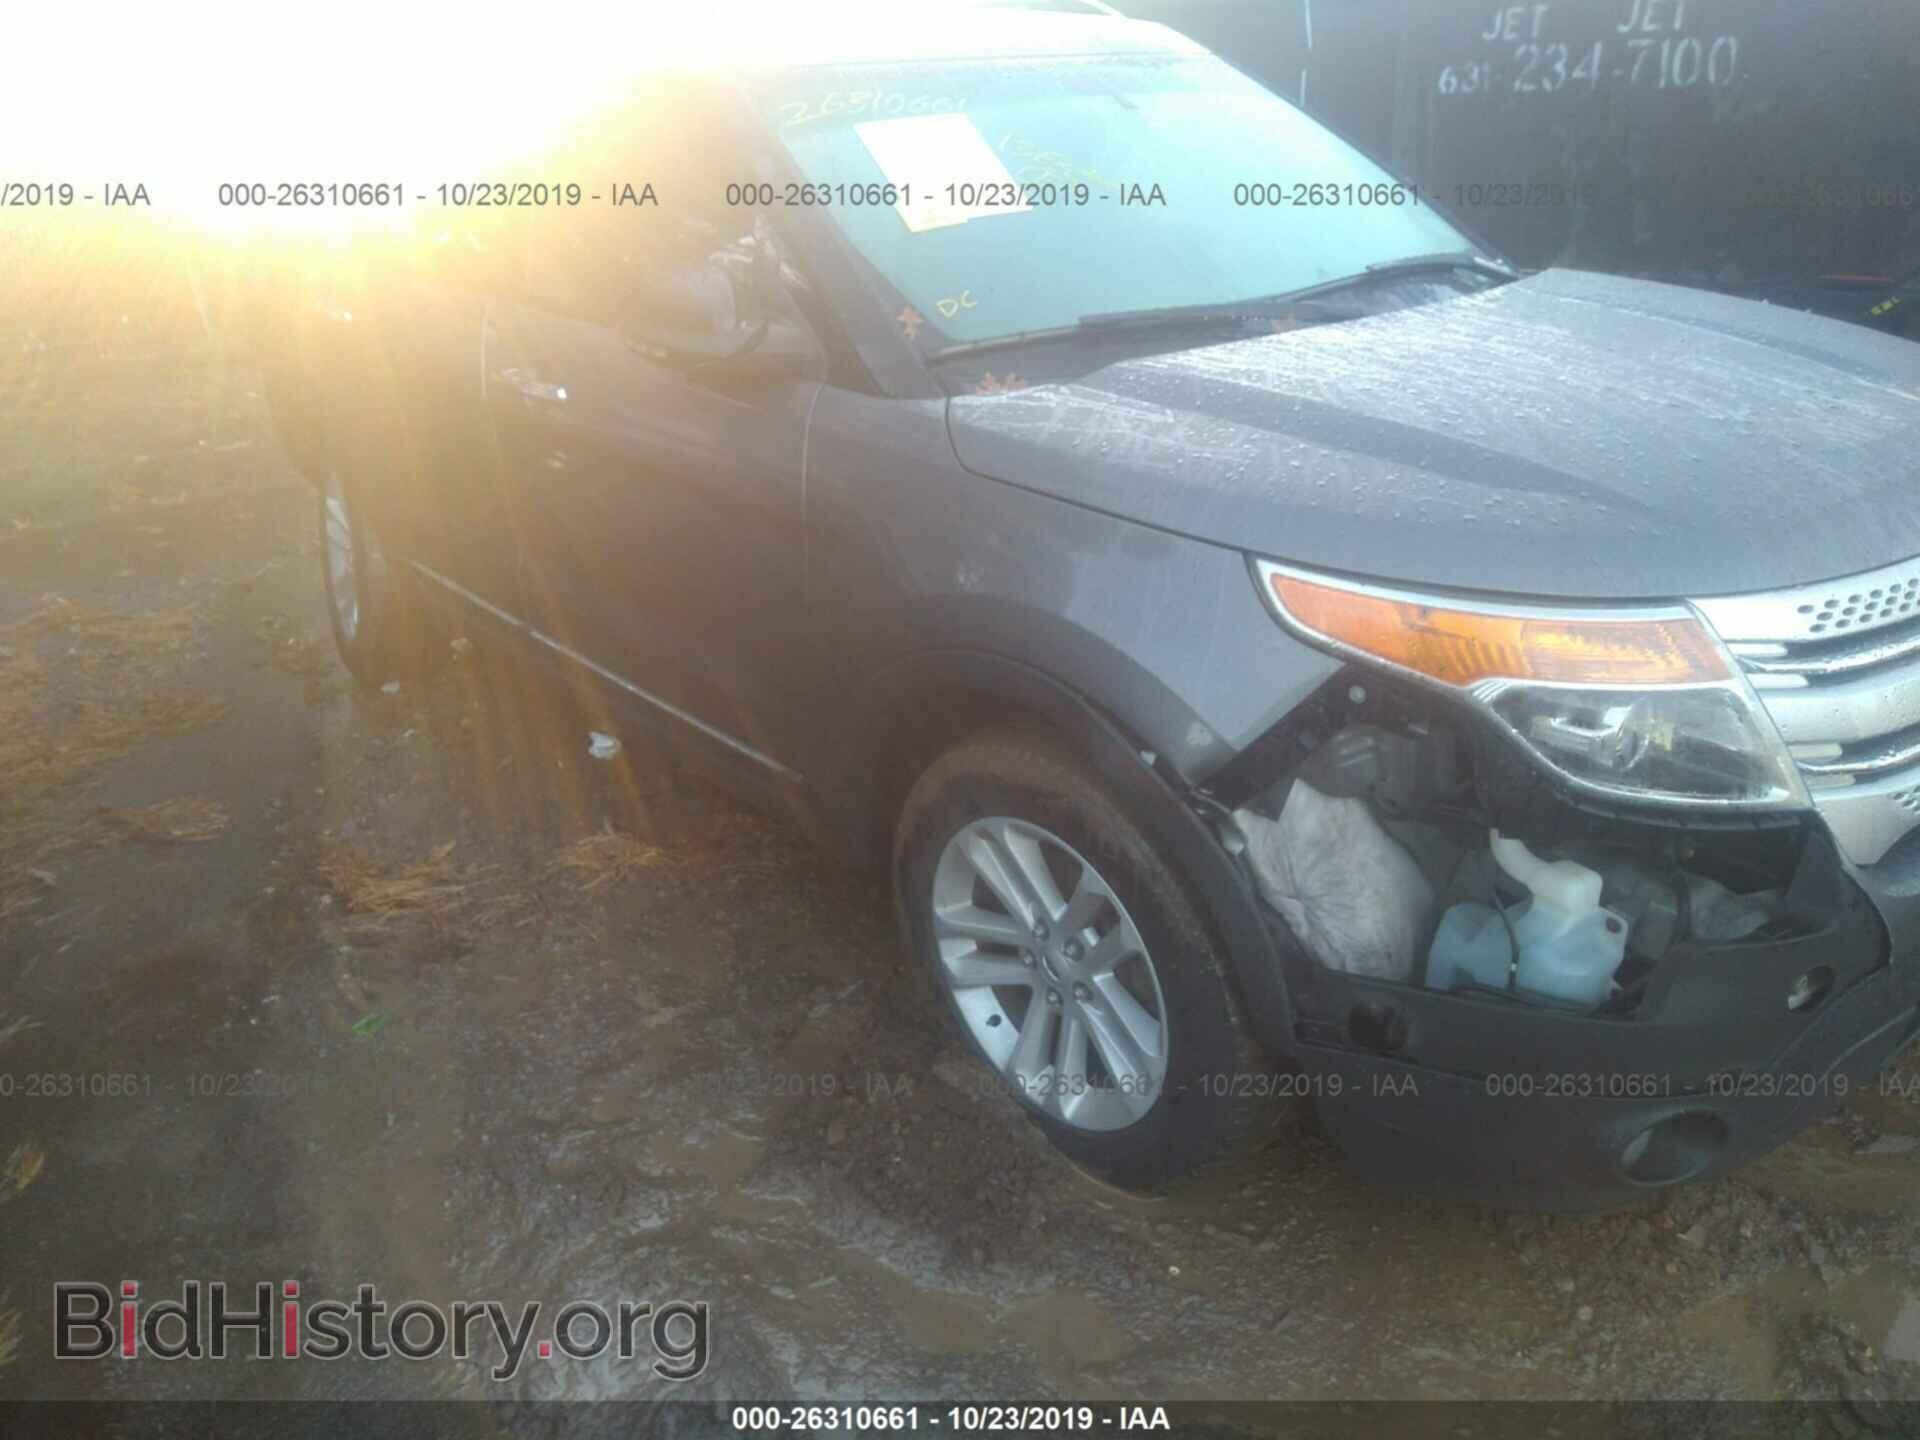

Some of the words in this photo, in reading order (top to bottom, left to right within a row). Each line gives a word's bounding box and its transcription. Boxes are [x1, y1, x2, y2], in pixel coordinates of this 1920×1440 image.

[1482, 5, 1549, 41] JET
[1616, 0, 1688, 33] JET
[937, 290, 978, 318] DC
